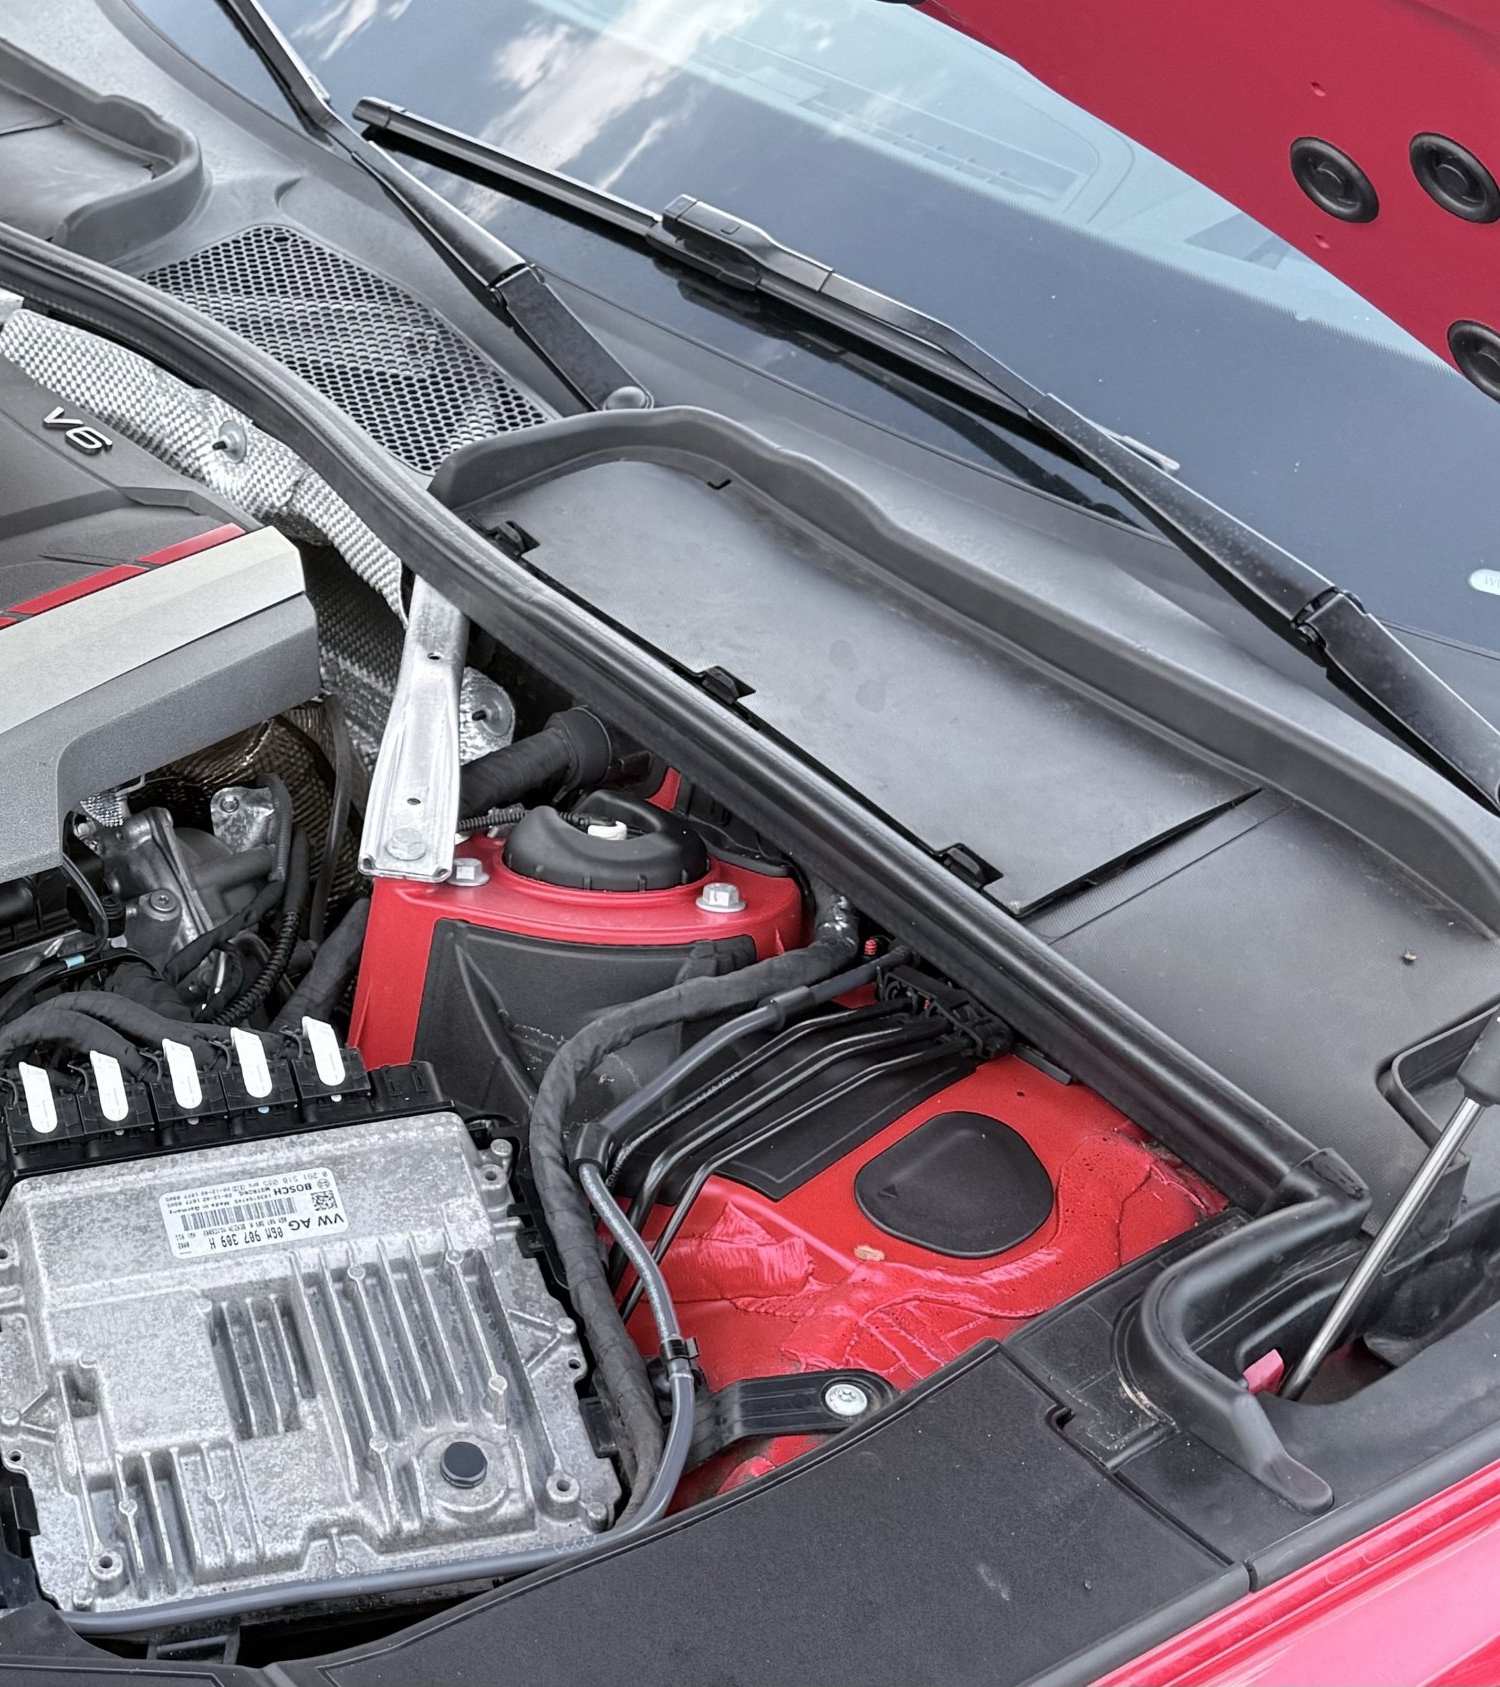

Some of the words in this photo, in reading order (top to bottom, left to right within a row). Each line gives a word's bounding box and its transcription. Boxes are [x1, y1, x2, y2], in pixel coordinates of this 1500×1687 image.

[43, 406, 113, 454] V6
[274, 1183, 312, 1196] BOSCH
[288, 1218, 310, 1231] AG
[317, 1213, 344, 1226] VW
[244, 1231, 261, 1244] 907
[266, 1227, 283, 1240] 06M
[209, 1238, 216, 1249] H
[221, 1235, 238, 1248] 309
